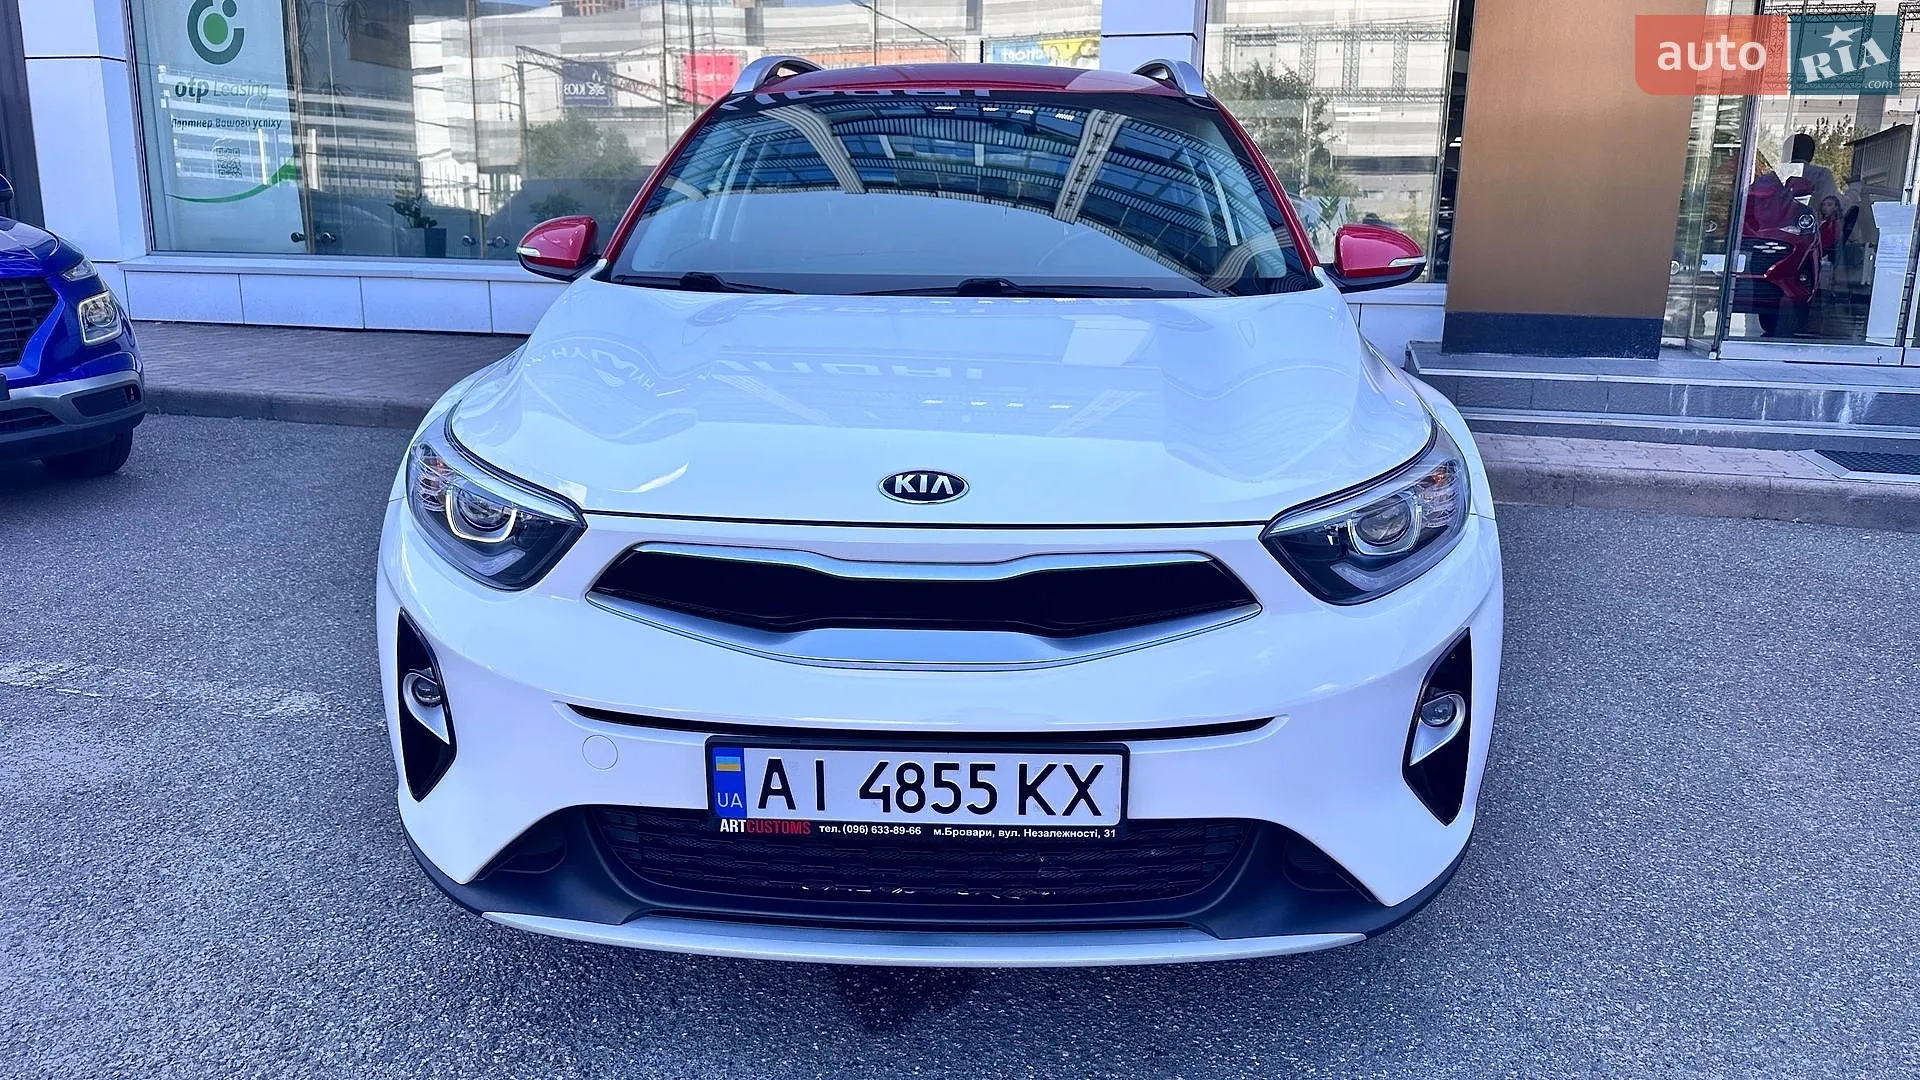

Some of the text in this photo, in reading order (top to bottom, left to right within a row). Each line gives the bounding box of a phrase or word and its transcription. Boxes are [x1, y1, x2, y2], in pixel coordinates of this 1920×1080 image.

[175, 77, 270, 103] otp Leasing
[215, 118, 251, 129] Вашого
[252, 117, 282, 130] успіху
[894, 474, 954, 495] KIA
[757, 757, 1104, 816] AI 4855 KX
[717, 792, 743, 808] UA
[720, 818, 1116, 839] ARTCUSTOMS тел. (096) 633-89-66 м.Бровари, вул. Незалежності, 31
